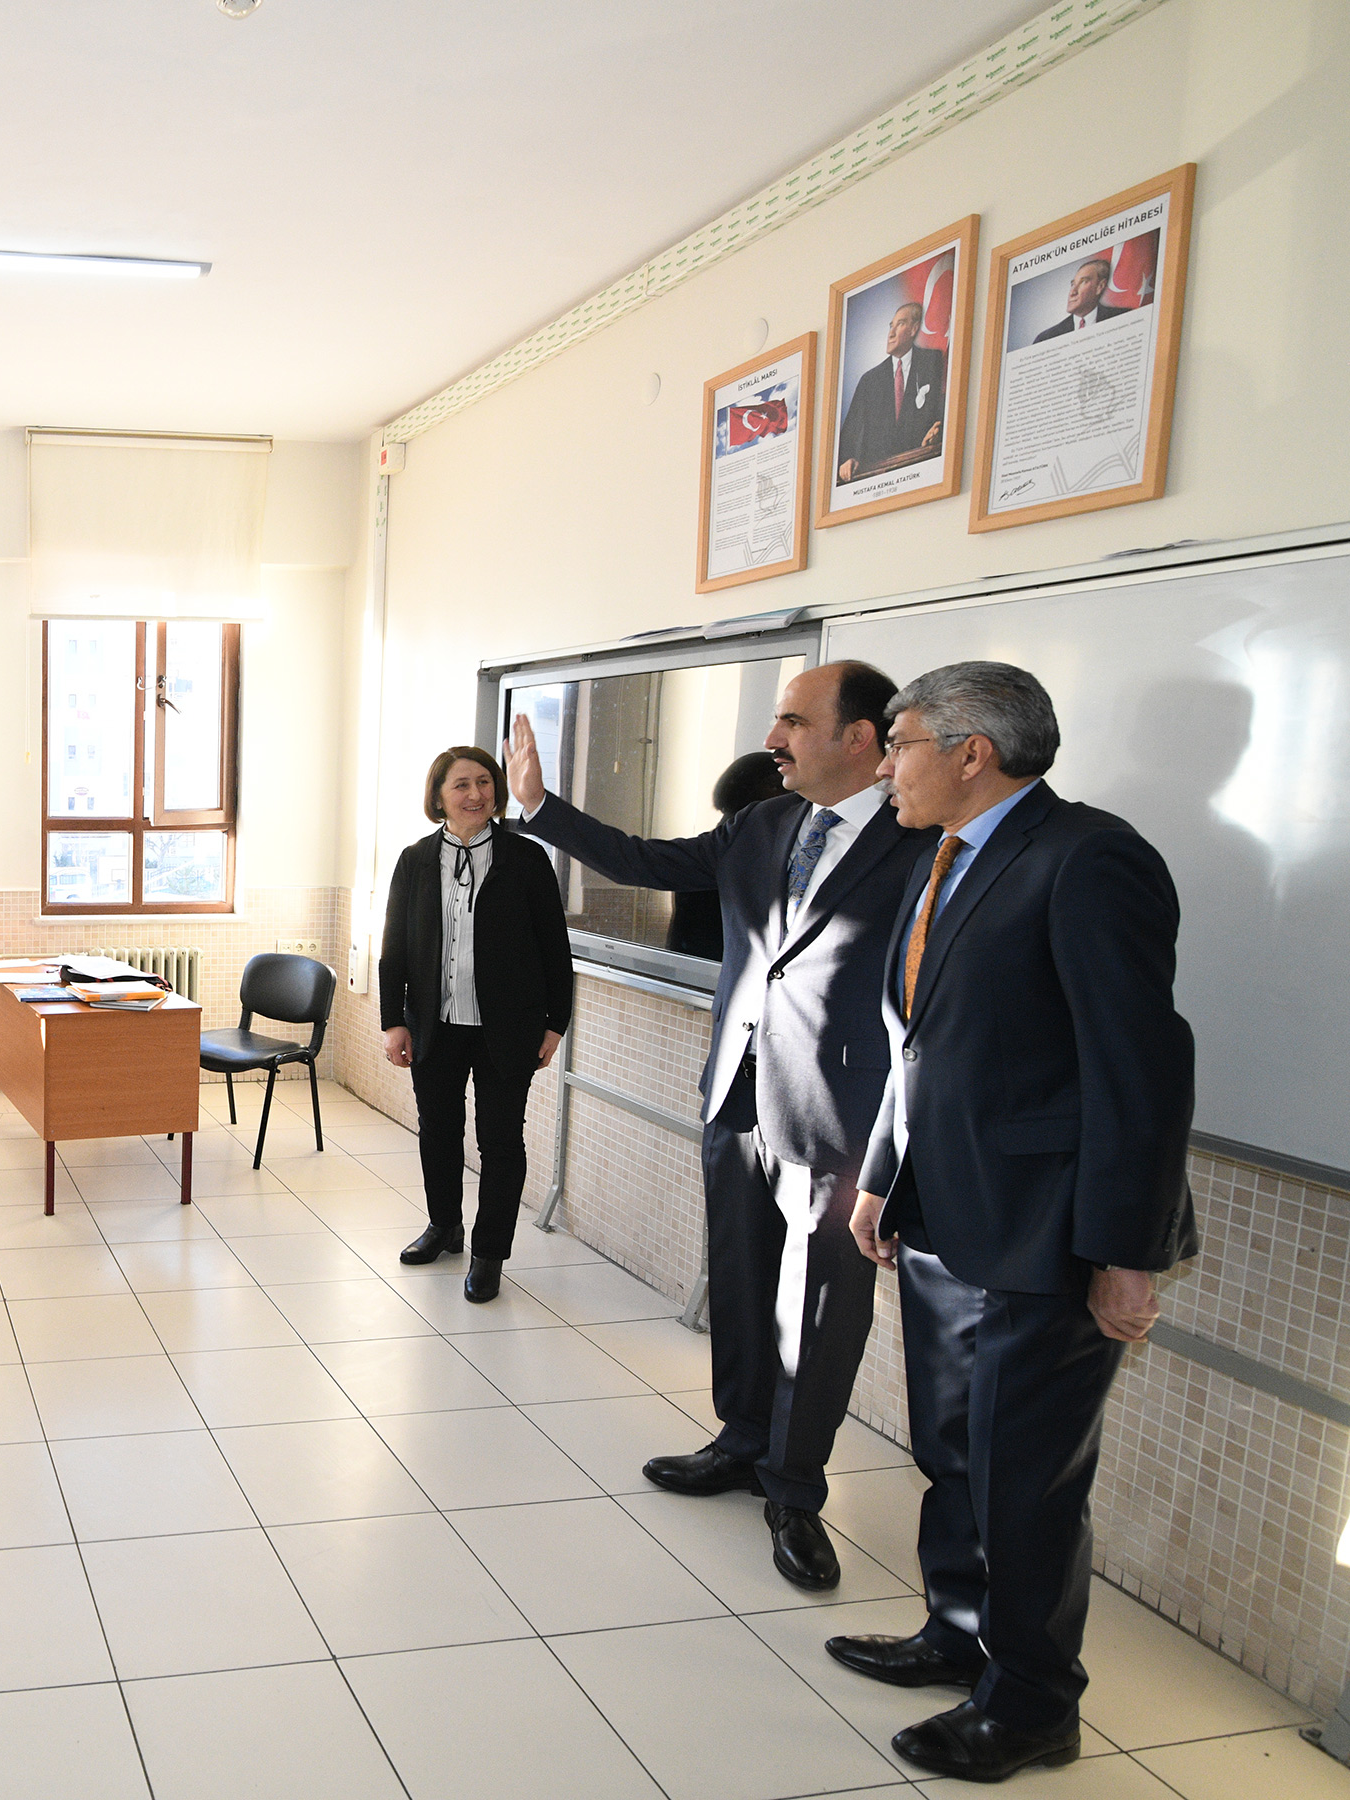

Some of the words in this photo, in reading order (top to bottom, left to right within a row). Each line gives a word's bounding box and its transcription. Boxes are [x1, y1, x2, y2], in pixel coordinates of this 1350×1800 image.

[1012, 244, 1068, 274] ATATÜRK'ÜN
[1069, 226, 1116, 252] GENÇLİĞE
[1118, 203, 1164, 232] HİTABESİ
[853, 486, 877, 497] MUSTAFA
[877, 480, 895, 490] KEMAL
[895, 472, 921, 484] ATATÜRK
